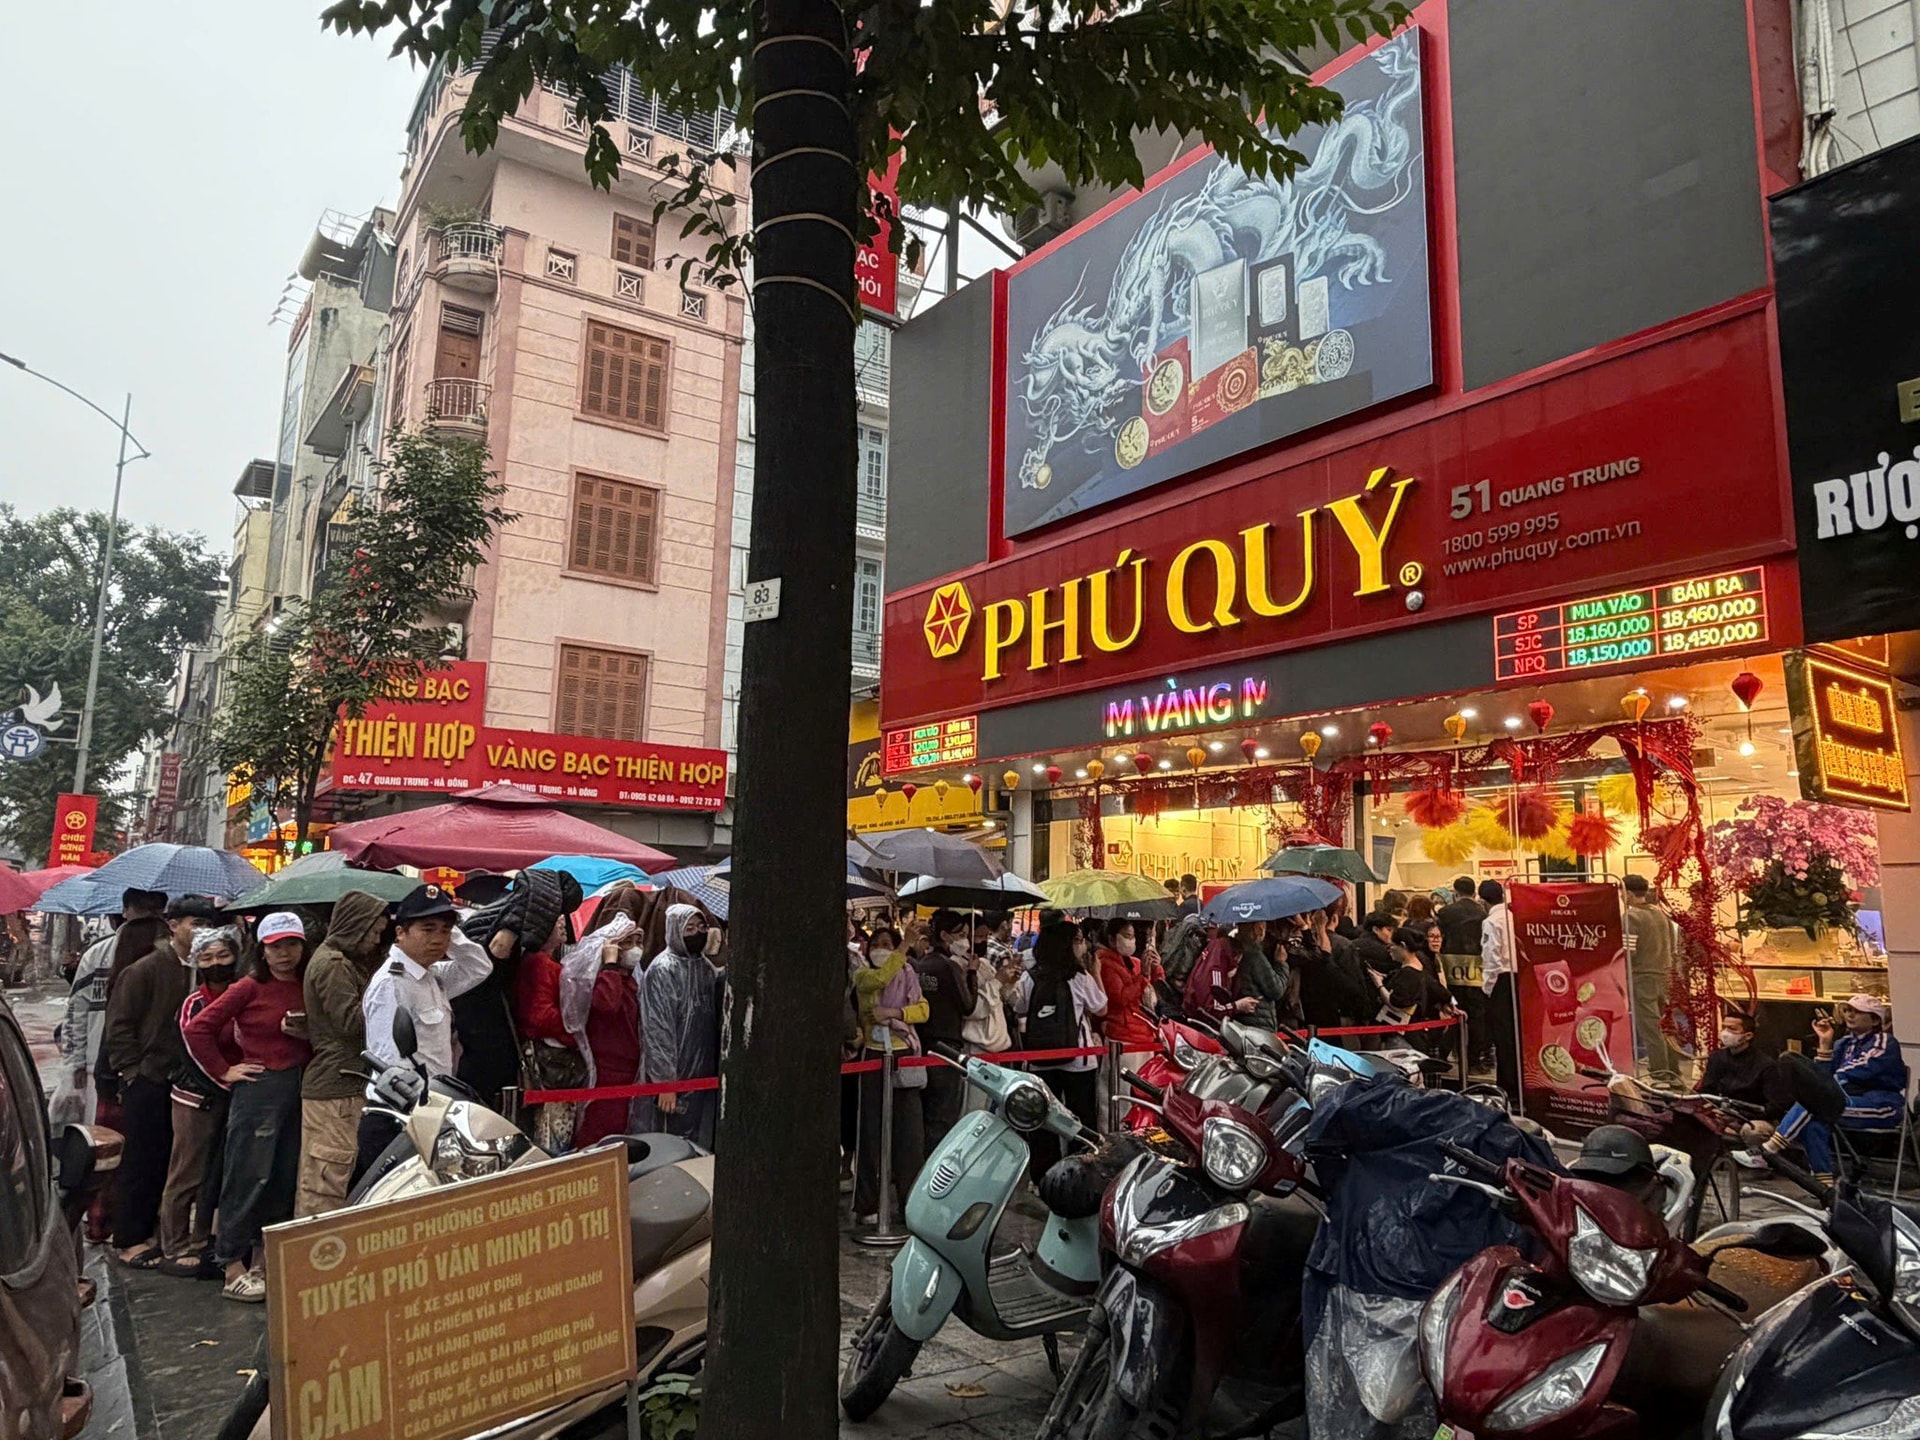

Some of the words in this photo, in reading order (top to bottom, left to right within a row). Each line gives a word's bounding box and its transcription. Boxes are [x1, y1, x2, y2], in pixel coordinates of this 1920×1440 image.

[857, 249, 879, 269] ẠC
[1450, 478, 1491, 520] 51
[1499, 476, 1566, 508] QUANG
[1568, 456, 1641, 489] TRUNG
[1443, 530, 1483, 556] 1800
[1487, 522, 1521, 545] 599
[1526, 511, 1560, 536] 995
[981, 548, 1147, 682] PHÚ
[1166, 466, 1416, 633] QUÝ
[754, 587, 769, 605] 83
[1517, 613, 1539, 631] SP
[1571, 599, 1607, 622] MUA
[1609, 590, 1643, 614] VÀO
[1671, 578, 1710, 604] BÁN
[1715, 575, 1744, 594] RA
[1514, 634, 1543, 654] SJC
[1513, 653, 1547, 674] NPQ
[424, 678, 470, 705] BẠC
[1141, 678, 1233, 732] VÀNG
[343, 713, 417, 765] THIỆN
[423, 719, 476, 766] HỢP
[358, 772, 373, 785] 47
[374, 776, 401, 786] QUANG
[403, 777, 429, 787] TRUNG
[487, 738, 557, 771] VÀNG
[563, 751, 610, 780] BẠC
[615, 754, 674, 785] THIỆN
[680, 760, 724, 789] HỢP
[539, 784, 562, 795] TRUNG
[1526, 923, 1561, 937] RINH
[1564, 922, 1607, 939] VÀNG
[357, 1224, 408, 1255] UBND
[413, 1202, 484, 1242] PHƯỜNG
[489, 1190, 544, 1221] QUANG
[548, 1175, 599, 1206] TRUNG
[298, 1265, 376, 1321] TUYẾN
[383, 1245, 430, 1298] PHỐ
[435, 1240, 481, 1282] VĂN
[486, 1226, 542, 1268] MINH
[547, 1213, 575, 1249] ĐÔ
[579, 1207, 611, 1240] THỊ
[424, 1296, 441, 1313] XE
[444, 1291, 464, 1307] SAI
[535, 1282, 563, 1302] KINH
[565, 1270, 602, 1292] DOANH
[513, 1339, 529, 1355] RA
[300, 1345, 382, 1440] CẤM
